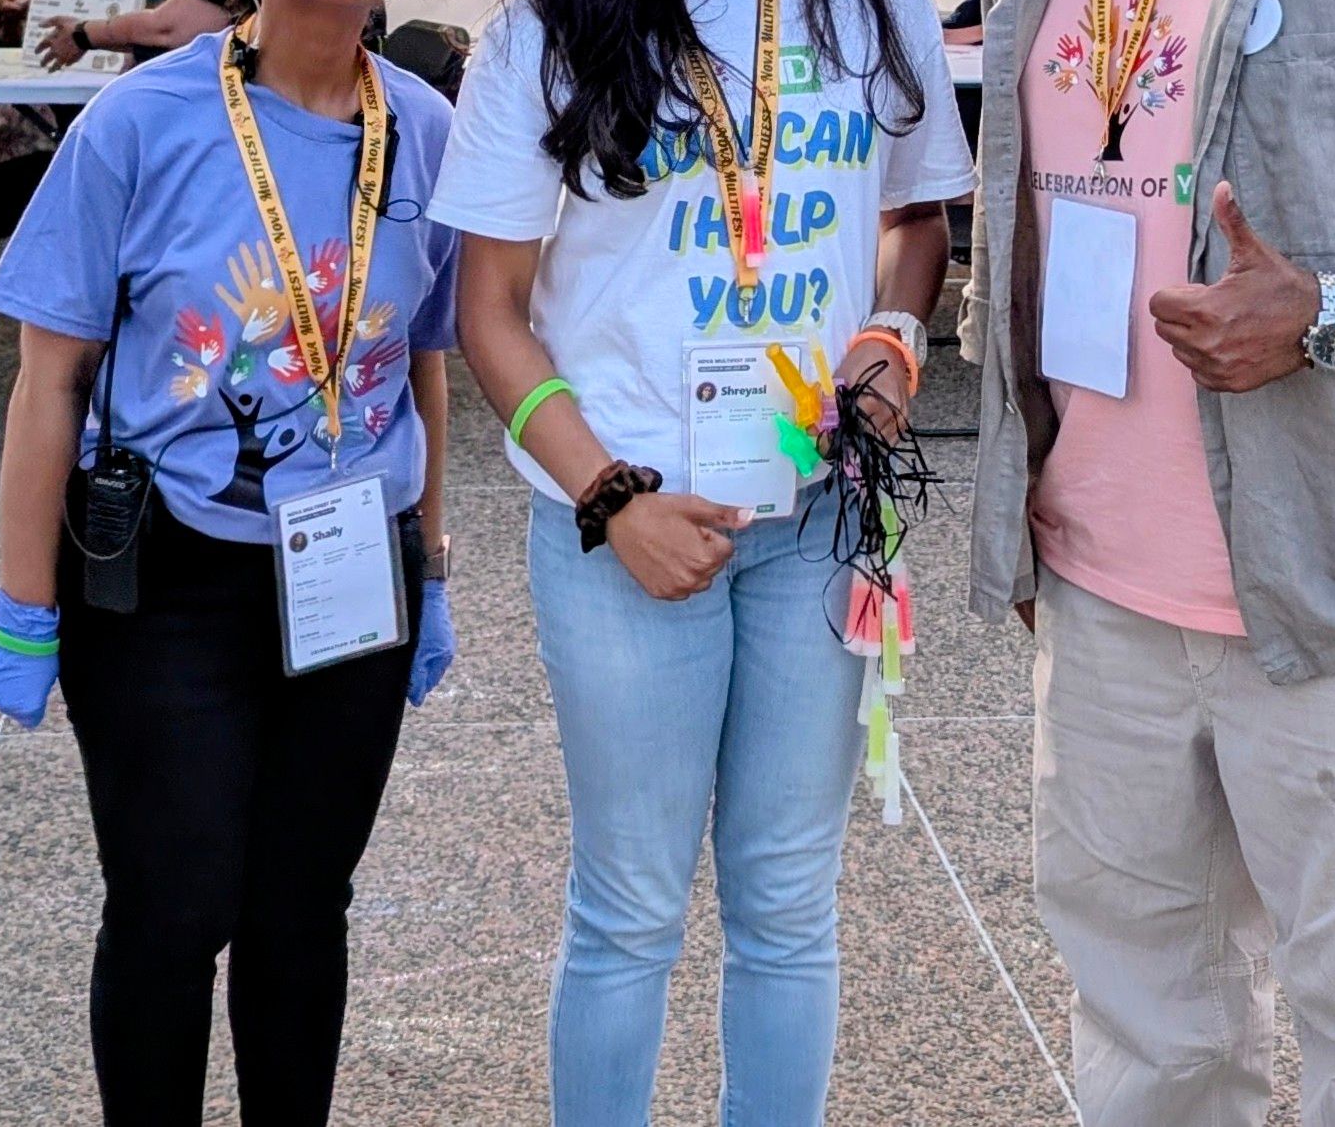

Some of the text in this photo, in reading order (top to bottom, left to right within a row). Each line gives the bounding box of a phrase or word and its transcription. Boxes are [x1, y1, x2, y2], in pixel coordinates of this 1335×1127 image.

[760, 49, 775, 82] NOVA
[1094, 50, 1106, 88] NOVA
[365, 136, 382, 174] NOVA
[773, 109, 873, 164] CAN
[241, 132, 288, 244] NOVA MULTIFEST
[723, 169, 744, 239] MULTIFEST
[1140, 177, 1169, 197] OF
[668, 200, 689, 251] I
[694, 190, 836, 249] HLP
[286, 269, 324, 376] NOVA MULTIFEST
